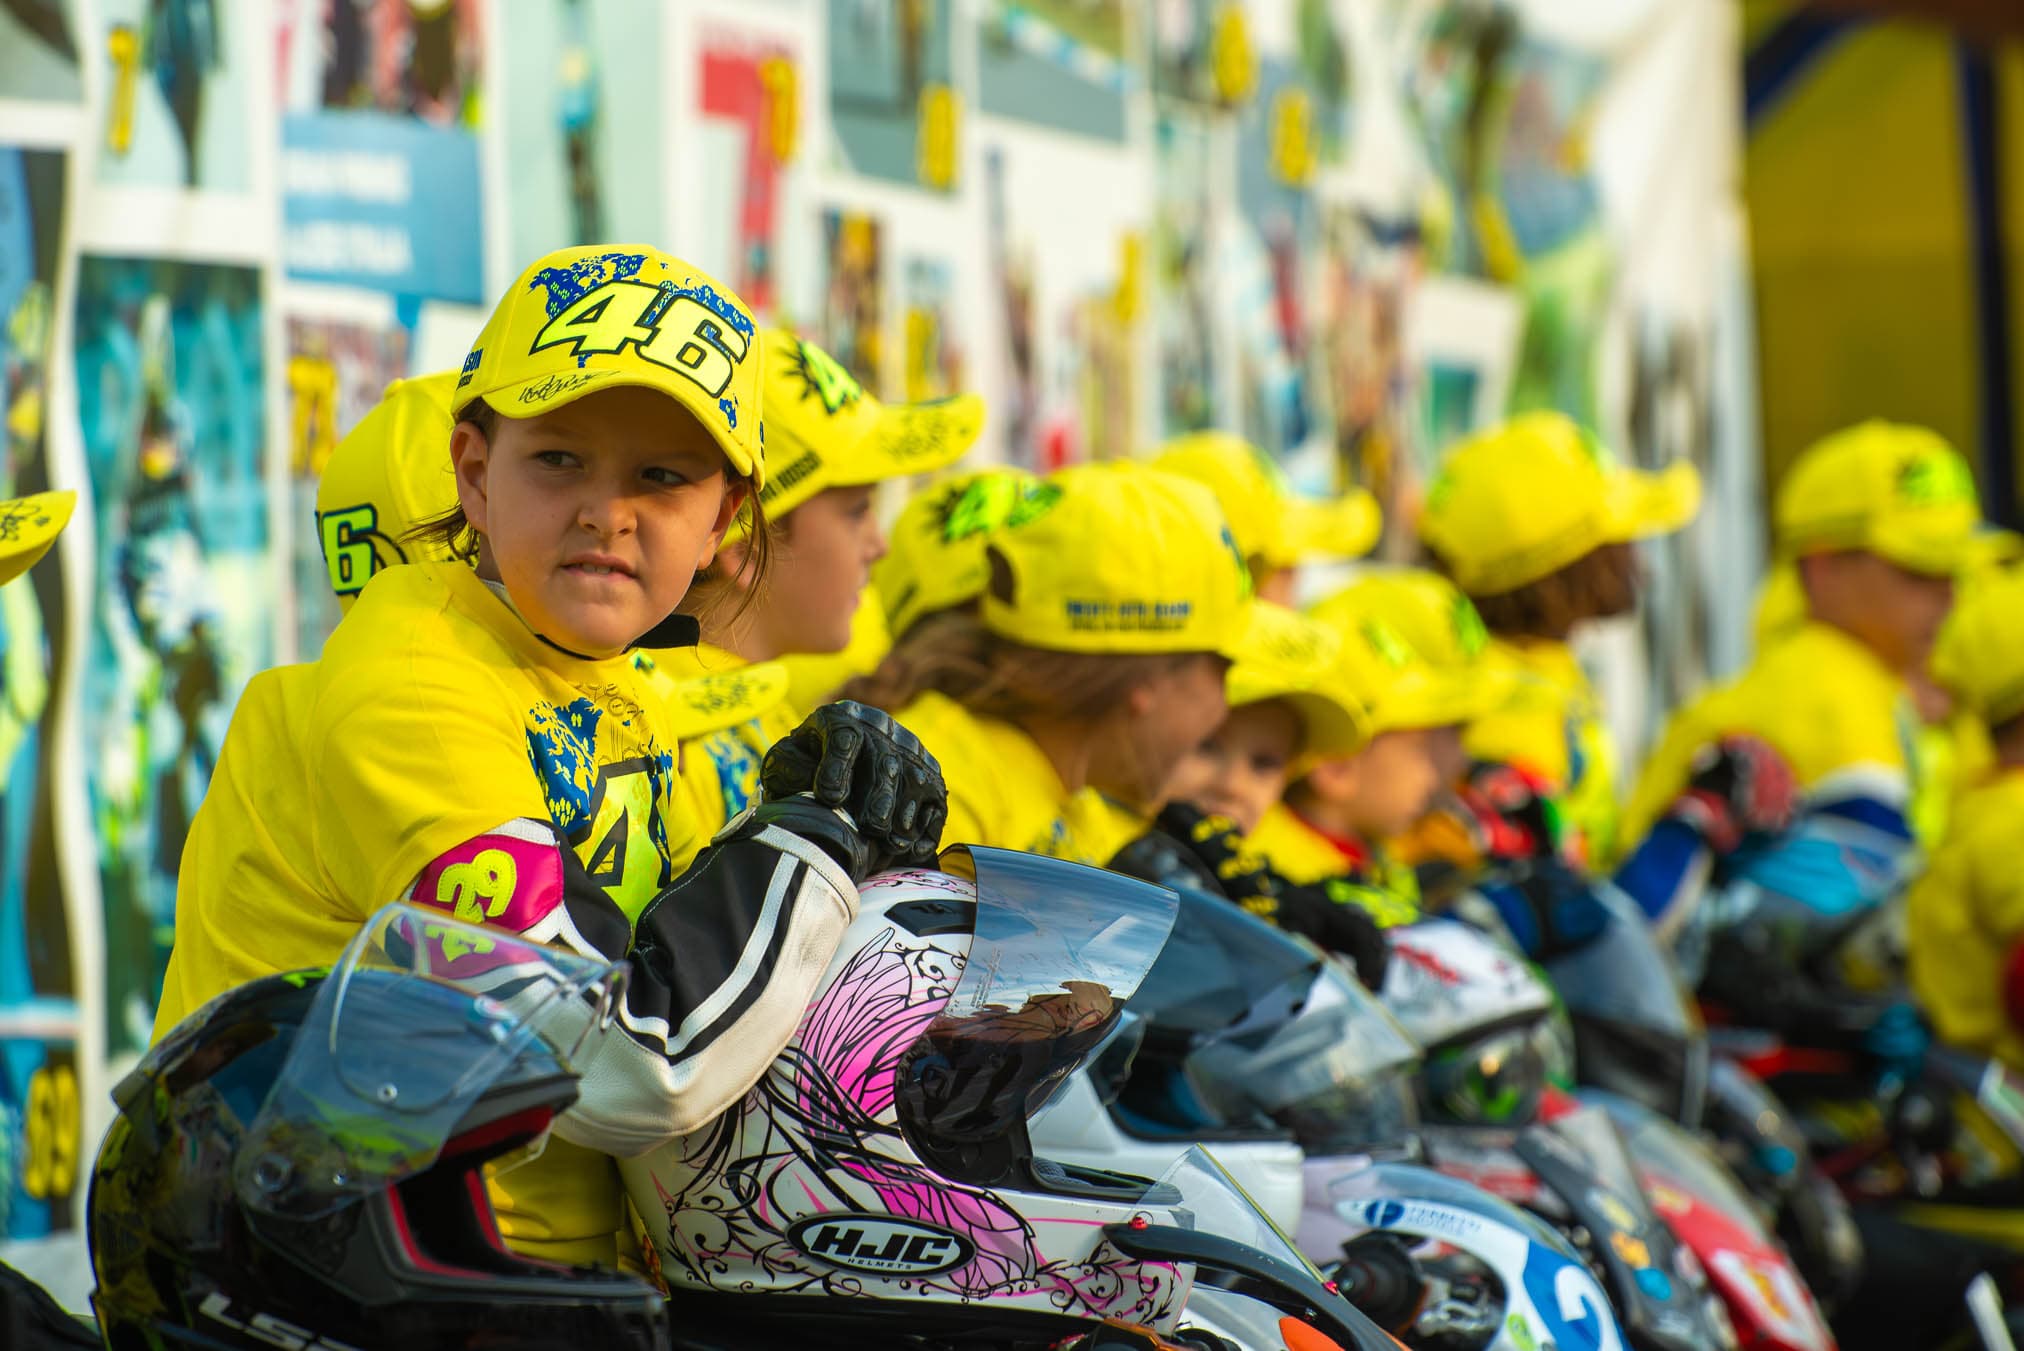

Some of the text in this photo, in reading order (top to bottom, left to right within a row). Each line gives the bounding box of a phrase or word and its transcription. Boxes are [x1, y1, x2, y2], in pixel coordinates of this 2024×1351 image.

[528, 279, 748, 399] 46
[315, 502, 378, 597] 6
[436, 848, 518, 924] 29
[810, 1224, 953, 1266] HJC
[847, 1258, 913, 1270] HELMETS
[199, 1291, 366, 1351] LS
